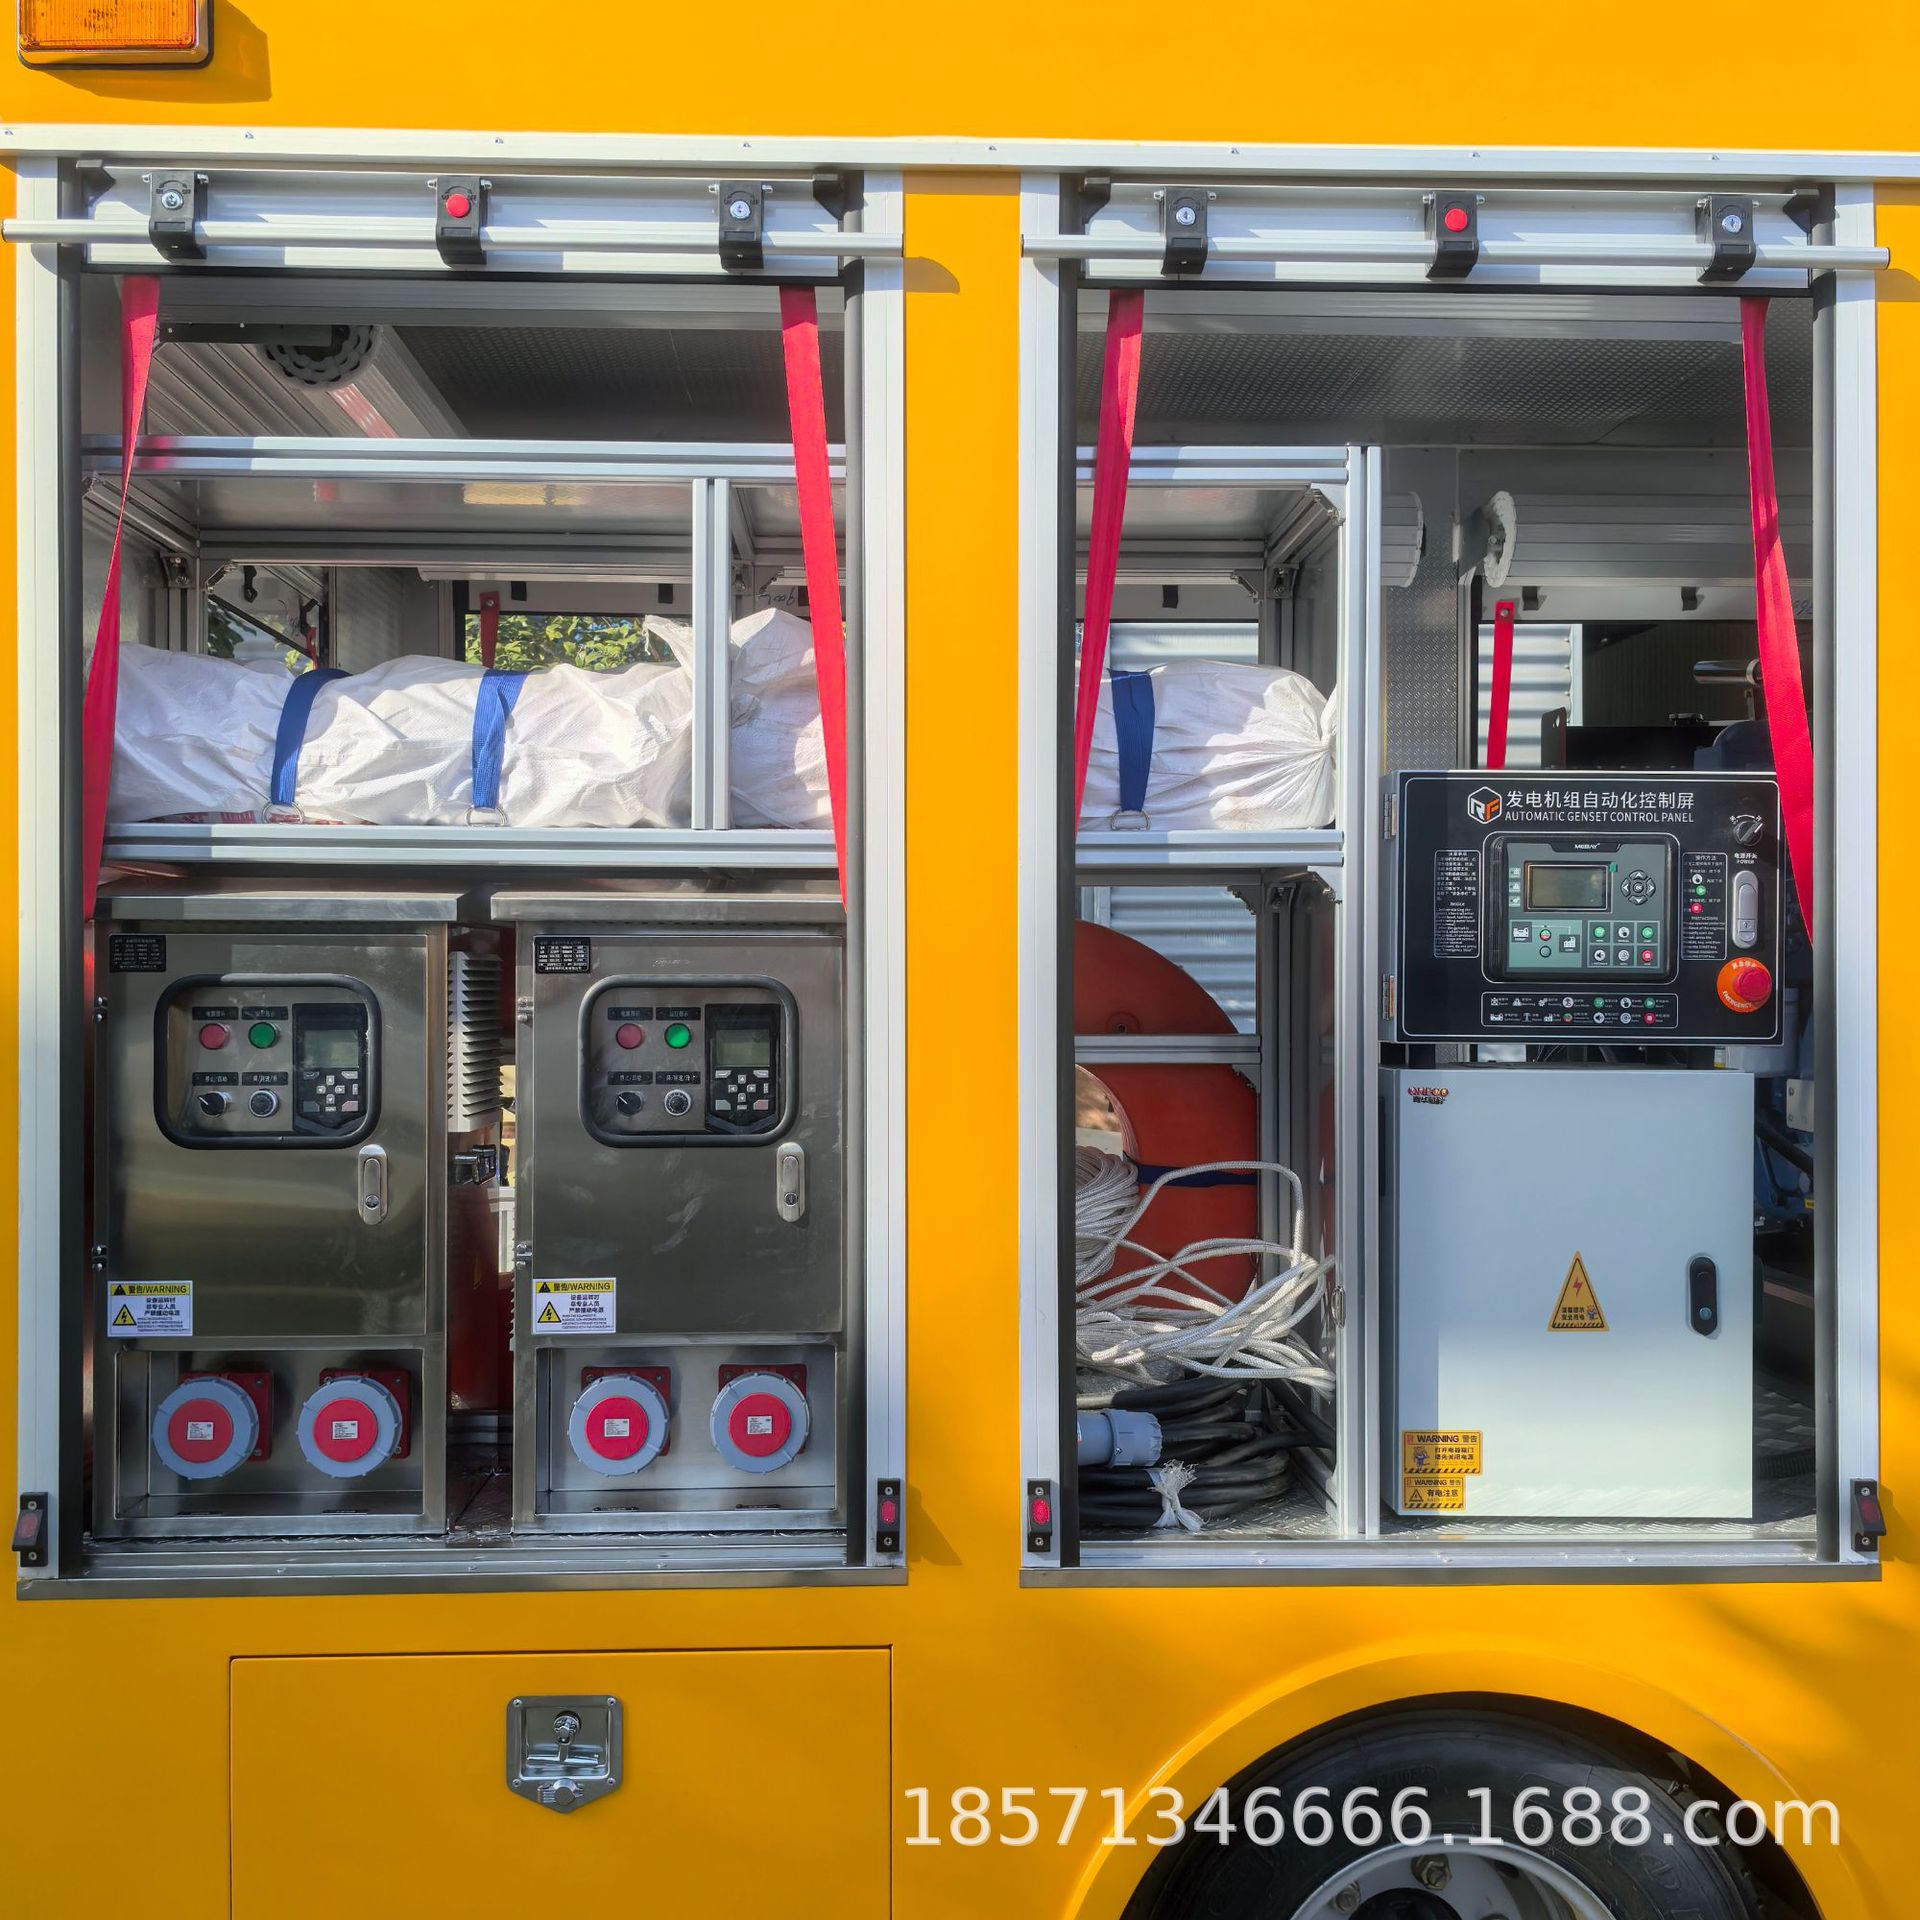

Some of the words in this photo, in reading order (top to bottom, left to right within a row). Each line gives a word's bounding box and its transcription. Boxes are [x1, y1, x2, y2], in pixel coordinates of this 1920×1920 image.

[1506, 791, 1694, 809] 发电机组自动化控制屏
[1505, 811, 1565, 822] AUTOMATIC
[1567, 811, 1606, 822] GENSET
[1609, 811, 1659, 822] CONTROL
[1661, 811, 1694, 822] PANEL
[128, 1285, 187, 1294] 警告/WARNING
[553, 1282, 611, 1291] 警告/WARNING
